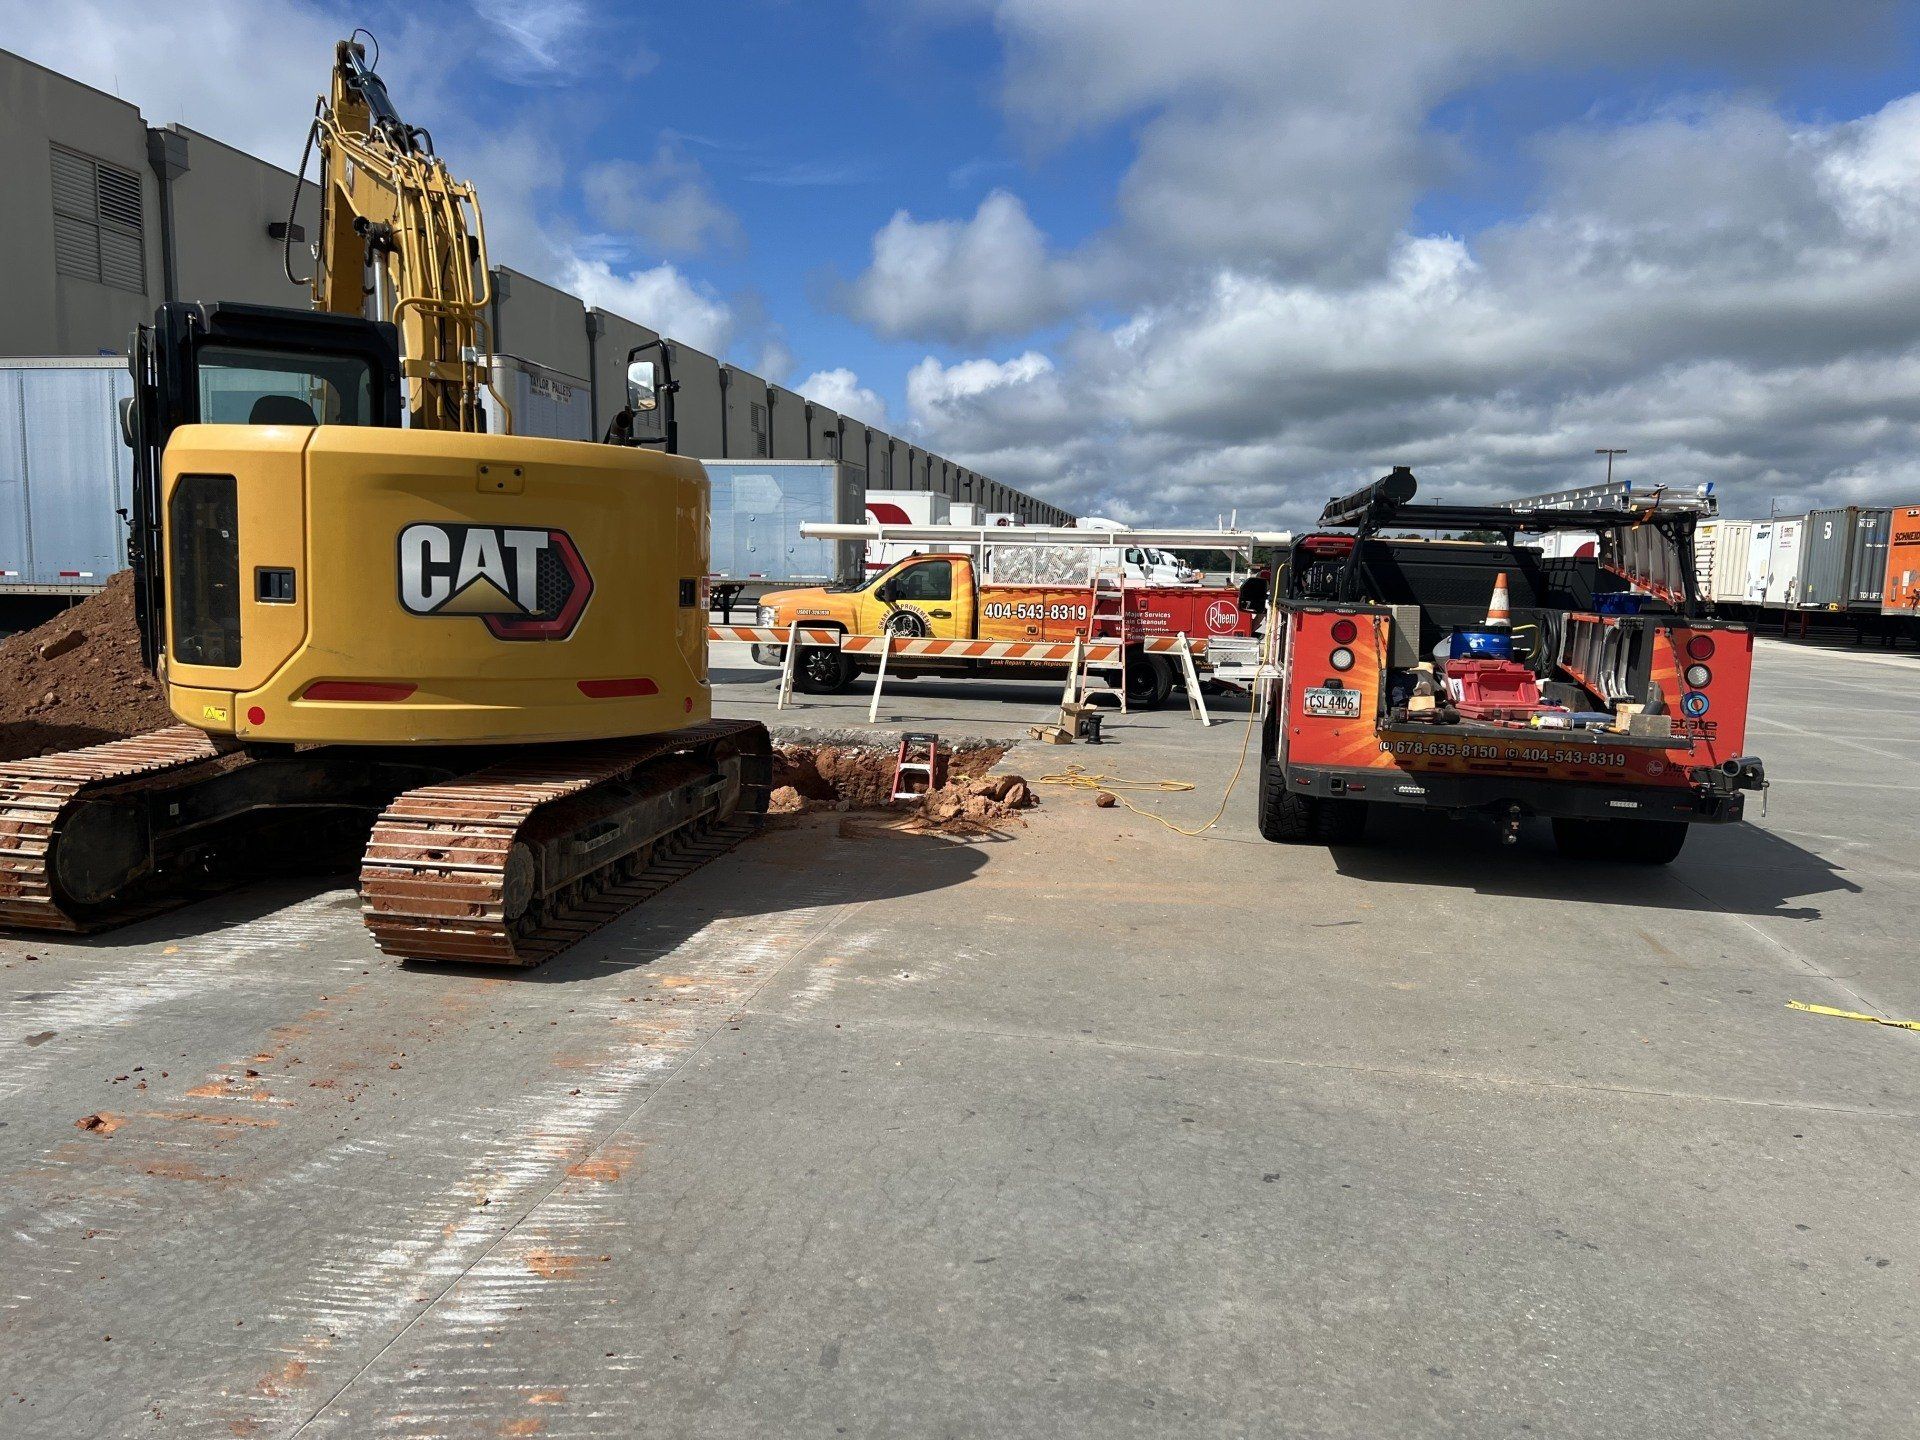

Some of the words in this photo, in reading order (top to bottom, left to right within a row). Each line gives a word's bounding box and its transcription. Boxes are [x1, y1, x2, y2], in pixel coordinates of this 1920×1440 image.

[401, 524, 549, 613] CAT
[984, 602, 1087, 621] 404-543-8319
[1136, 618, 1167, 626] Cleanouts
[1144, 611, 1171, 619] Services
[1209, 601, 1237, 629] Rheem
[1396, 741, 1498, 759] 678-635-8150
[1521, 748, 1626, 767] 404-543-8319
